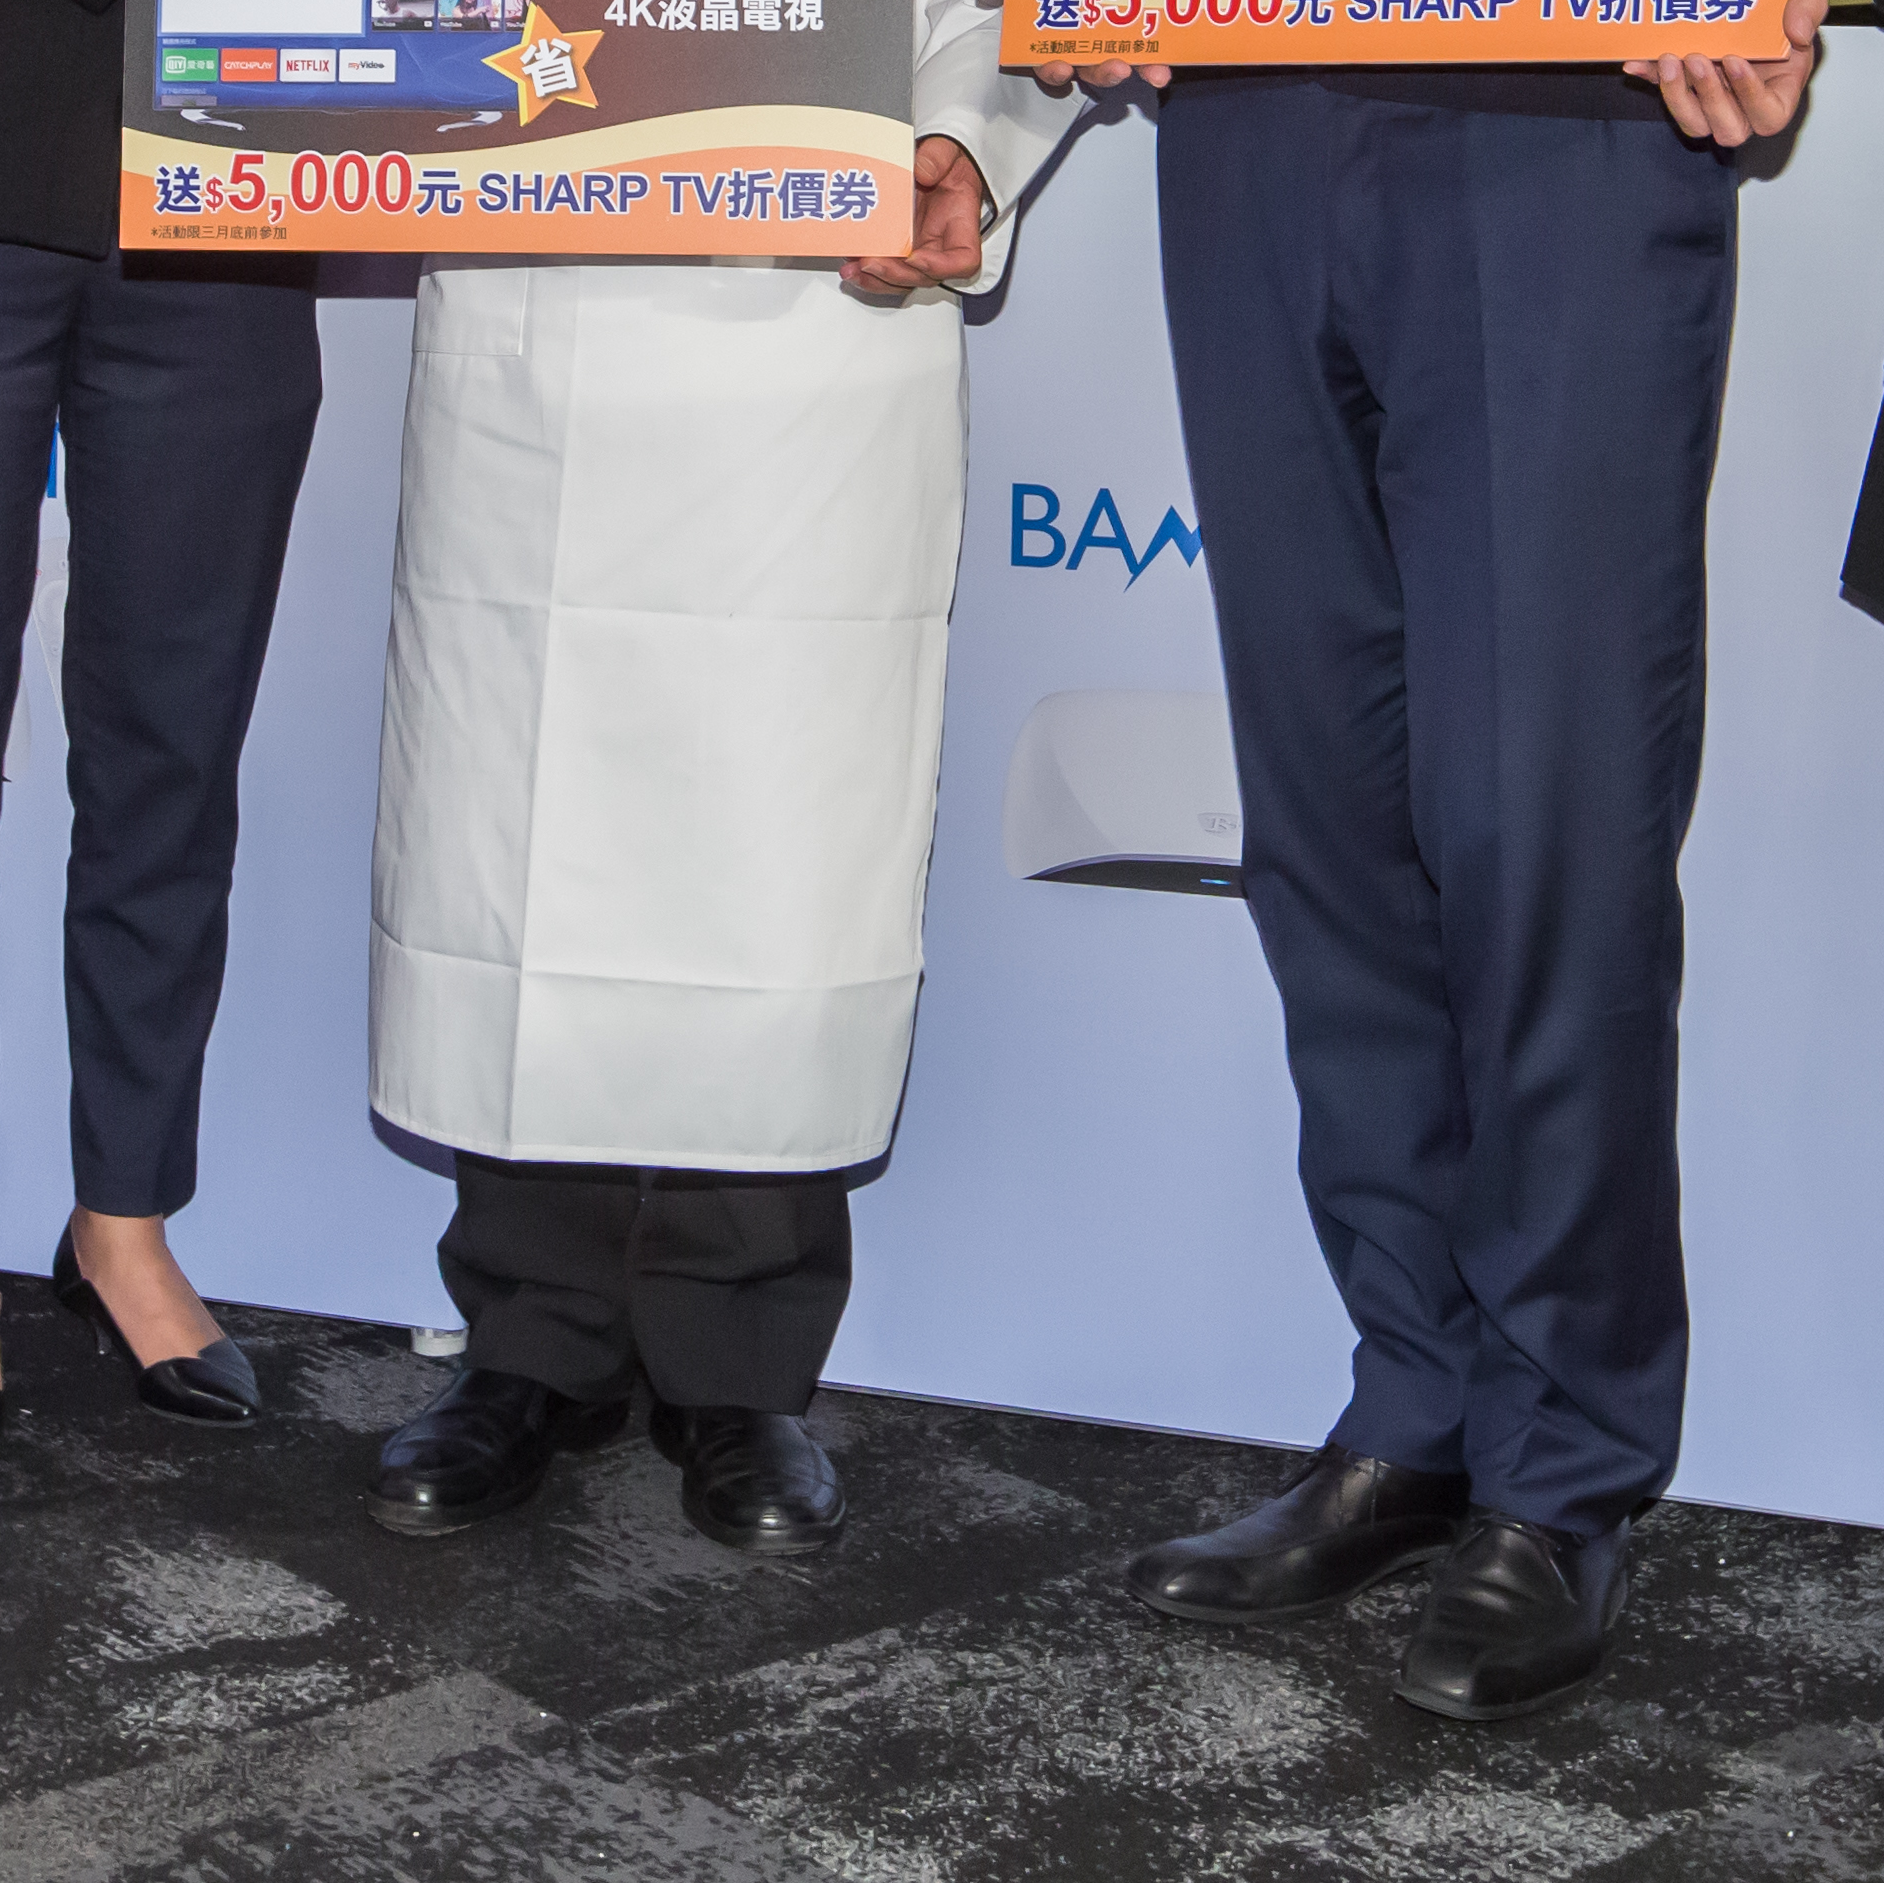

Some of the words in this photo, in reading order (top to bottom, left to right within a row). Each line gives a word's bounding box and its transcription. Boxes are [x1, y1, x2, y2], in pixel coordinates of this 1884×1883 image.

[286, 60, 330, 72] NETFLIX
[520, 38, 573, 97] 省
[154, 152, 462, 223] 送$5,000元
[477, 171, 649, 216] SHARP
[661, 170, 877, 221] TV折價券
